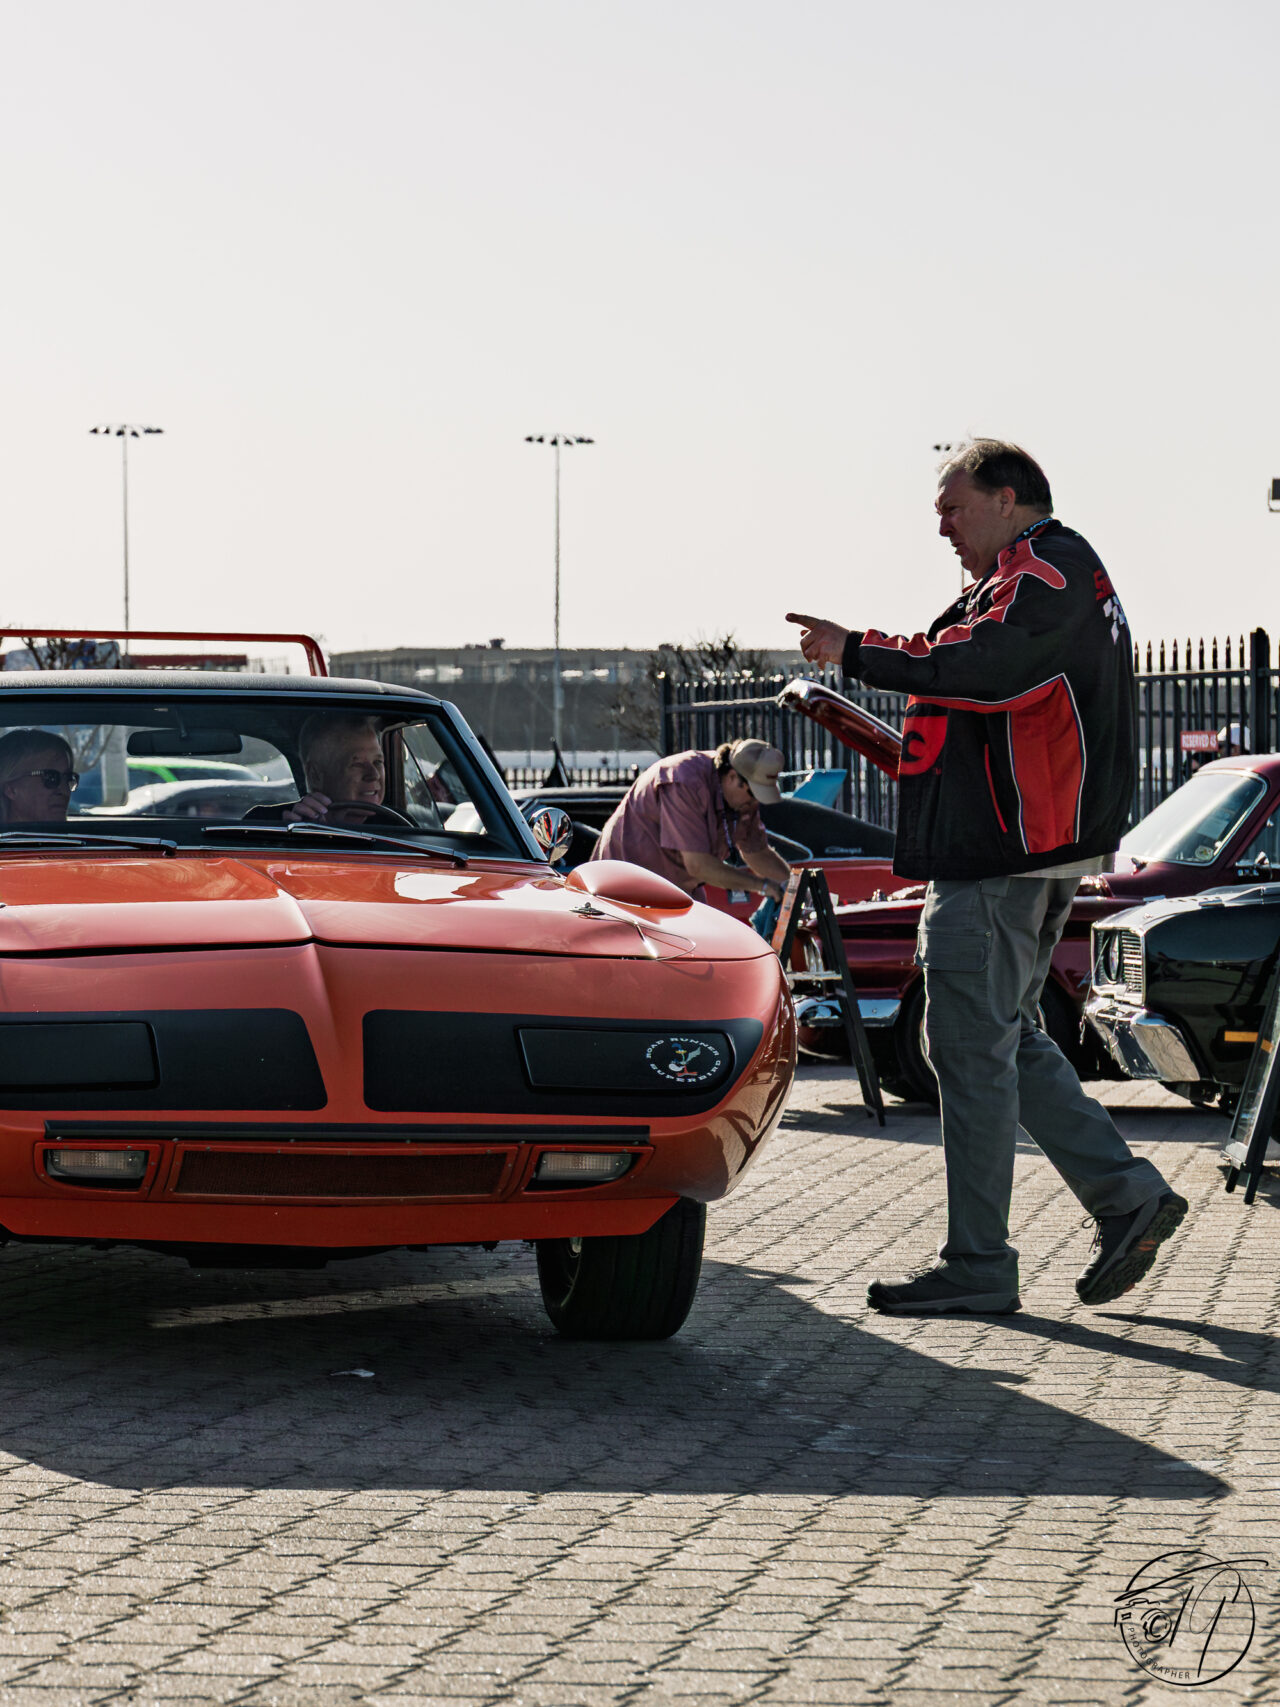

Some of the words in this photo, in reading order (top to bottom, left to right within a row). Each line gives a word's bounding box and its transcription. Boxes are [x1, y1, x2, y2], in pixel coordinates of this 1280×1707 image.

[645, 1039, 665, 1059] ROAD
[669, 1037, 719, 1056] RUNNER
[650, 1060, 721, 1083] SUPERBIRD
